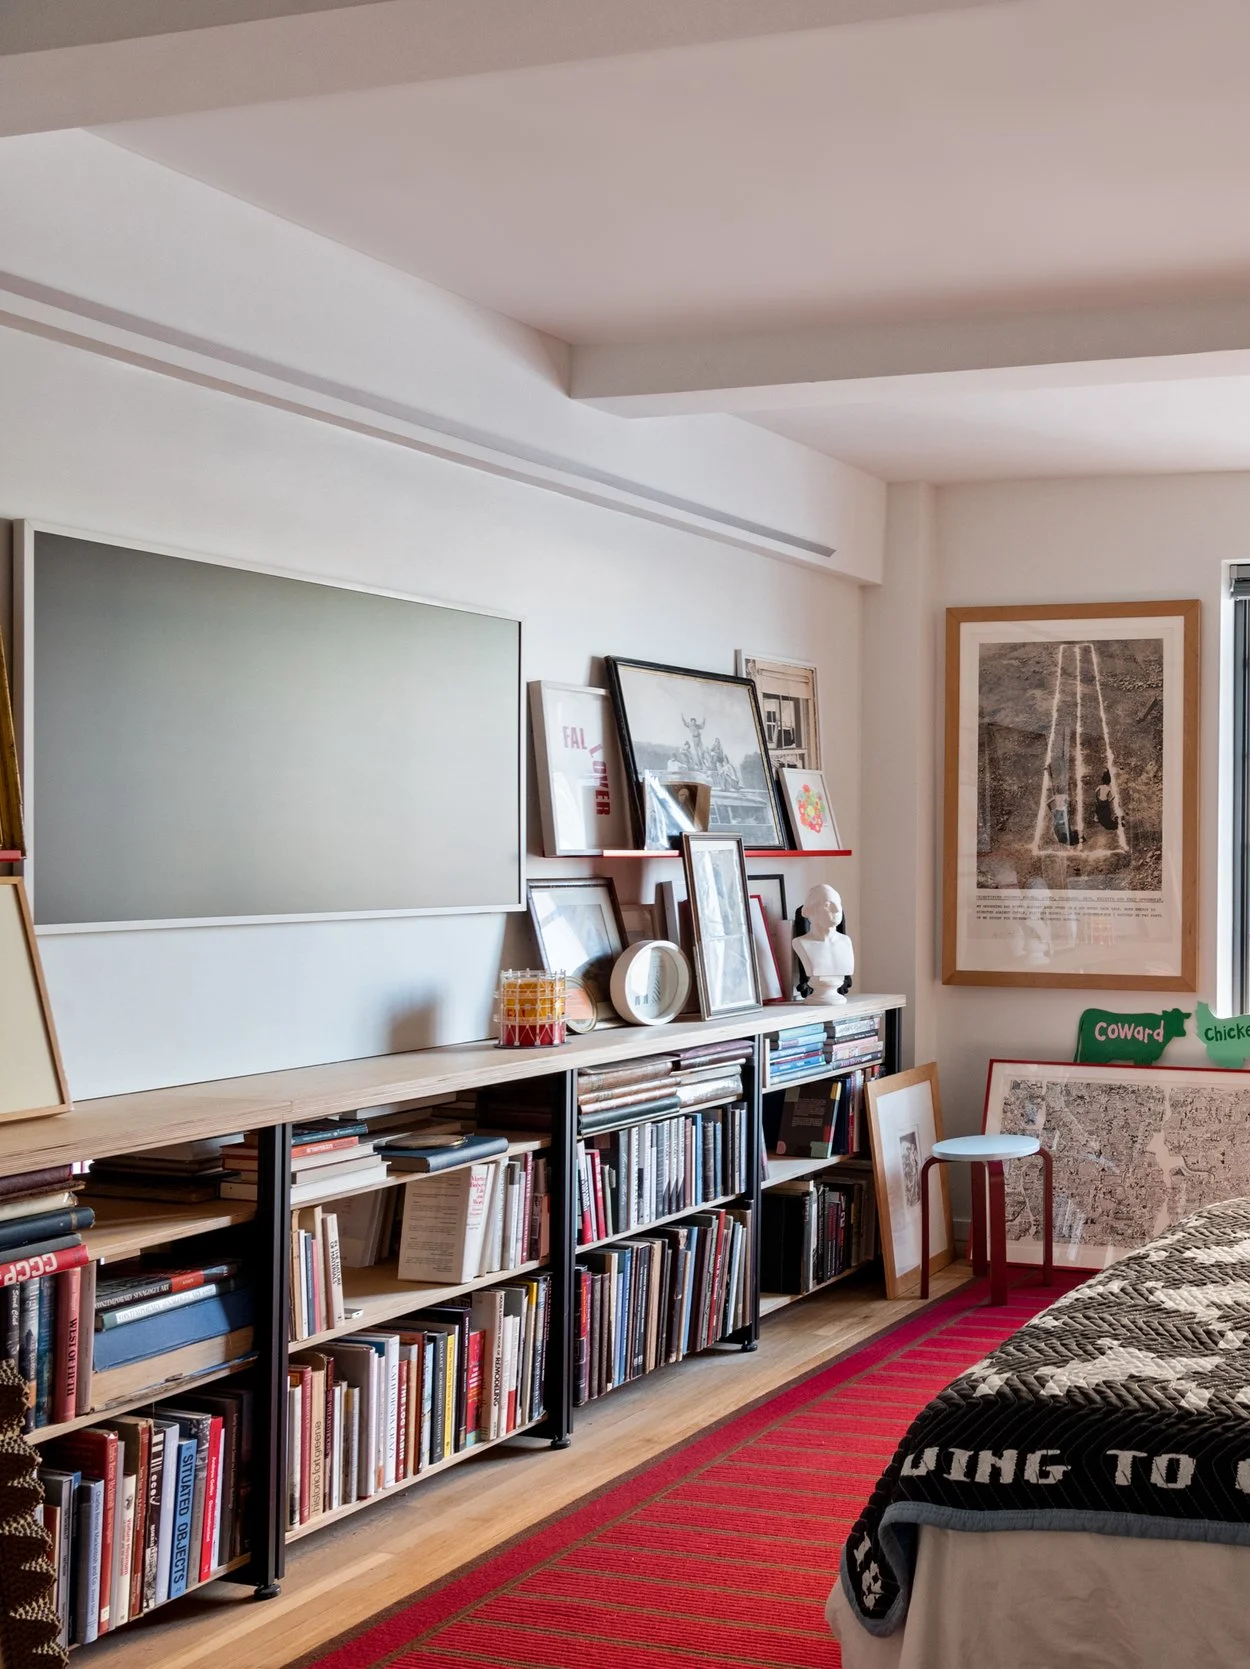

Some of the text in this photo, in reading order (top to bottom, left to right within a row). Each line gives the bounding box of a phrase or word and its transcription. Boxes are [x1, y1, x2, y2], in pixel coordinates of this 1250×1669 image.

[4, 1252, 58, 1286] CCCP
[68, 1318, 78, 1349] WEST
[68, 1350, 76, 1365] OF
[66, 1365, 75, 1397] FIFTH
[493, 1357, 502, 1407] REMODELING
[388, 1364, 397, 1460] CALIFORNIA CRAZY
[399, 1407, 407, 1426] LOG
[311, 1421, 322, 1513] historic fort greene
[1107, 1450, 1197, 1490] TO
[173, 1454, 194, 1584] SITUATED OBJECTS
